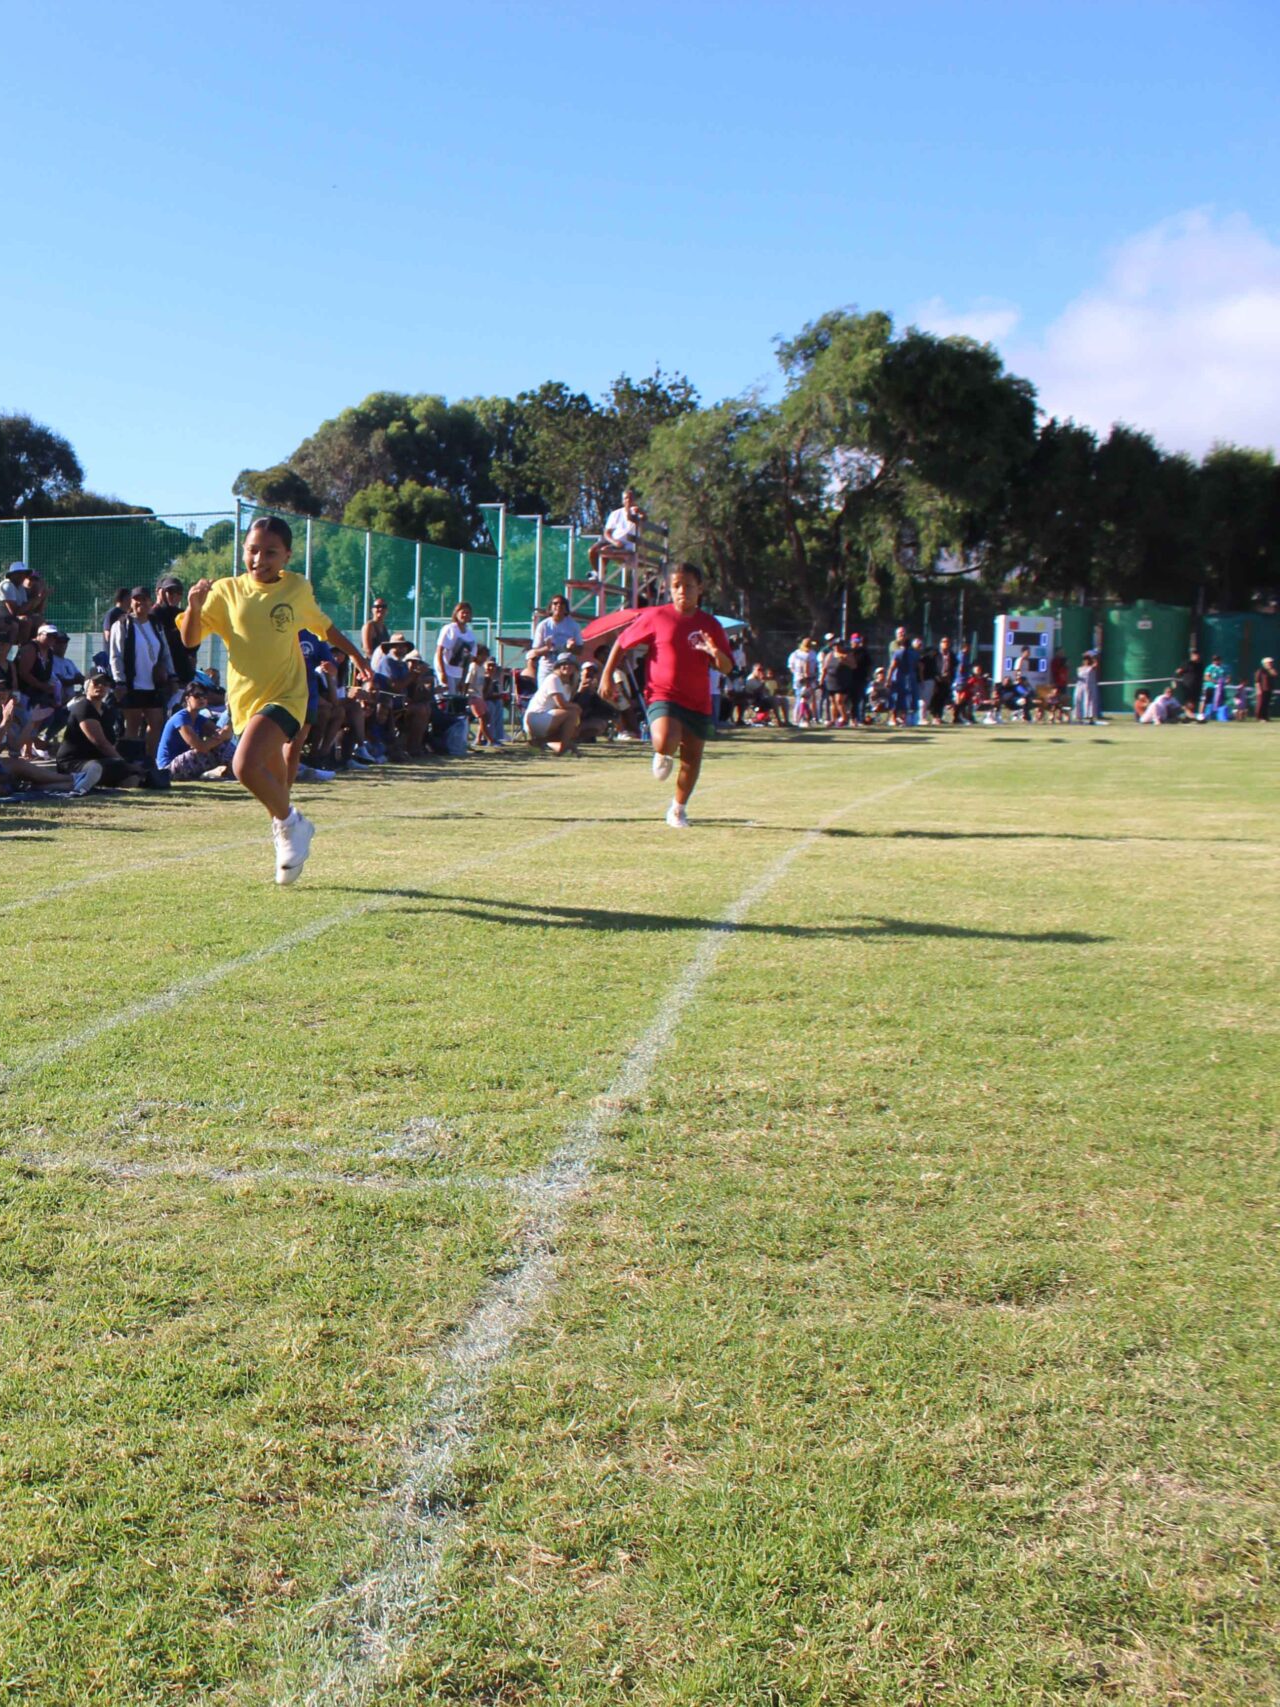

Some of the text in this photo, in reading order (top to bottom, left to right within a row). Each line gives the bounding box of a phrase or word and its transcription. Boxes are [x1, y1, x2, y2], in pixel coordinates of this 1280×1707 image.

[1007, 632, 1014, 645] 0
[1041, 633, 1048, 646] 0
[1005, 657, 1012, 671] 0
[1039, 658, 1047, 672] 0
